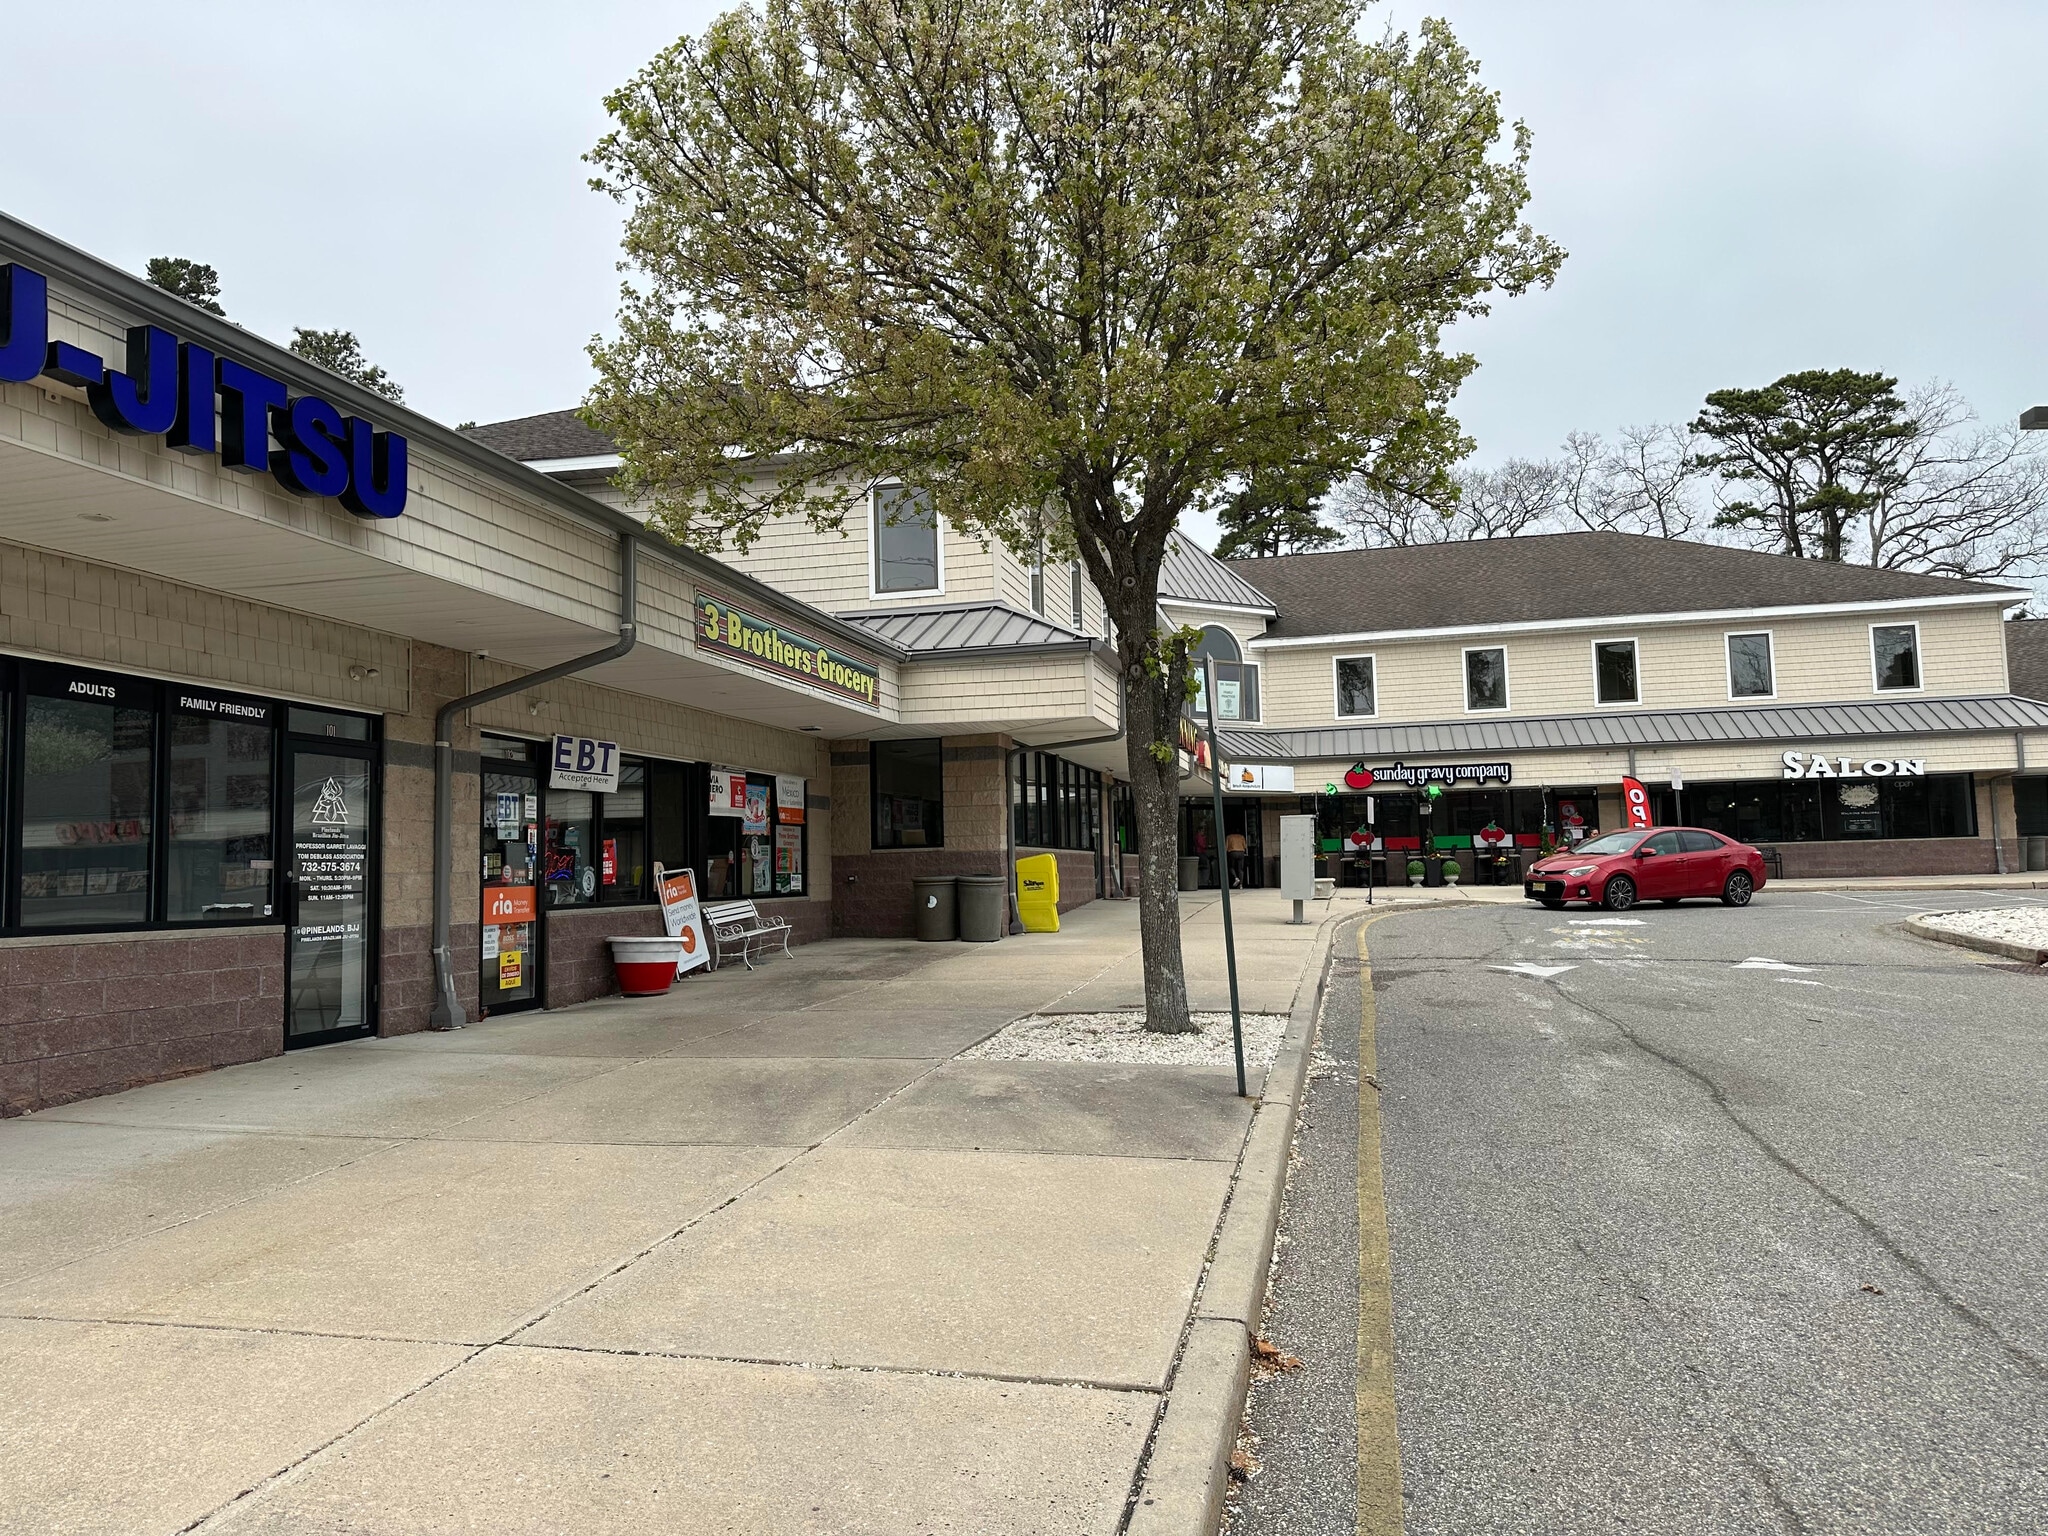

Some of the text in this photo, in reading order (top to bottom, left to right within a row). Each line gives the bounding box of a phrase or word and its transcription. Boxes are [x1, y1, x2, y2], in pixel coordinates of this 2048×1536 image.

[703, 602, 876, 703] 3 Brothers Grocery
[69, 681, 116, 698] ADULTS
[180, 696, 266, 719] FAMILY FRIENDLY
[326, 724, 337, 737] 101
[554, 735, 616, 774] EBT
[1782, 750, 1927, 779] SALON
[558, 772, 609, 785] Accepted Here
[1373, 763, 1509, 787] sunday gravy company
[497, 795, 519, 819] EBT
[301, 862, 361, 872] 732-575-3674
[666, 883, 679, 900] ria
[492, 892, 528, 916] ria Money
[667, 903, 693, 917] Send money
[670, 912, 697, 927] Worldwide
